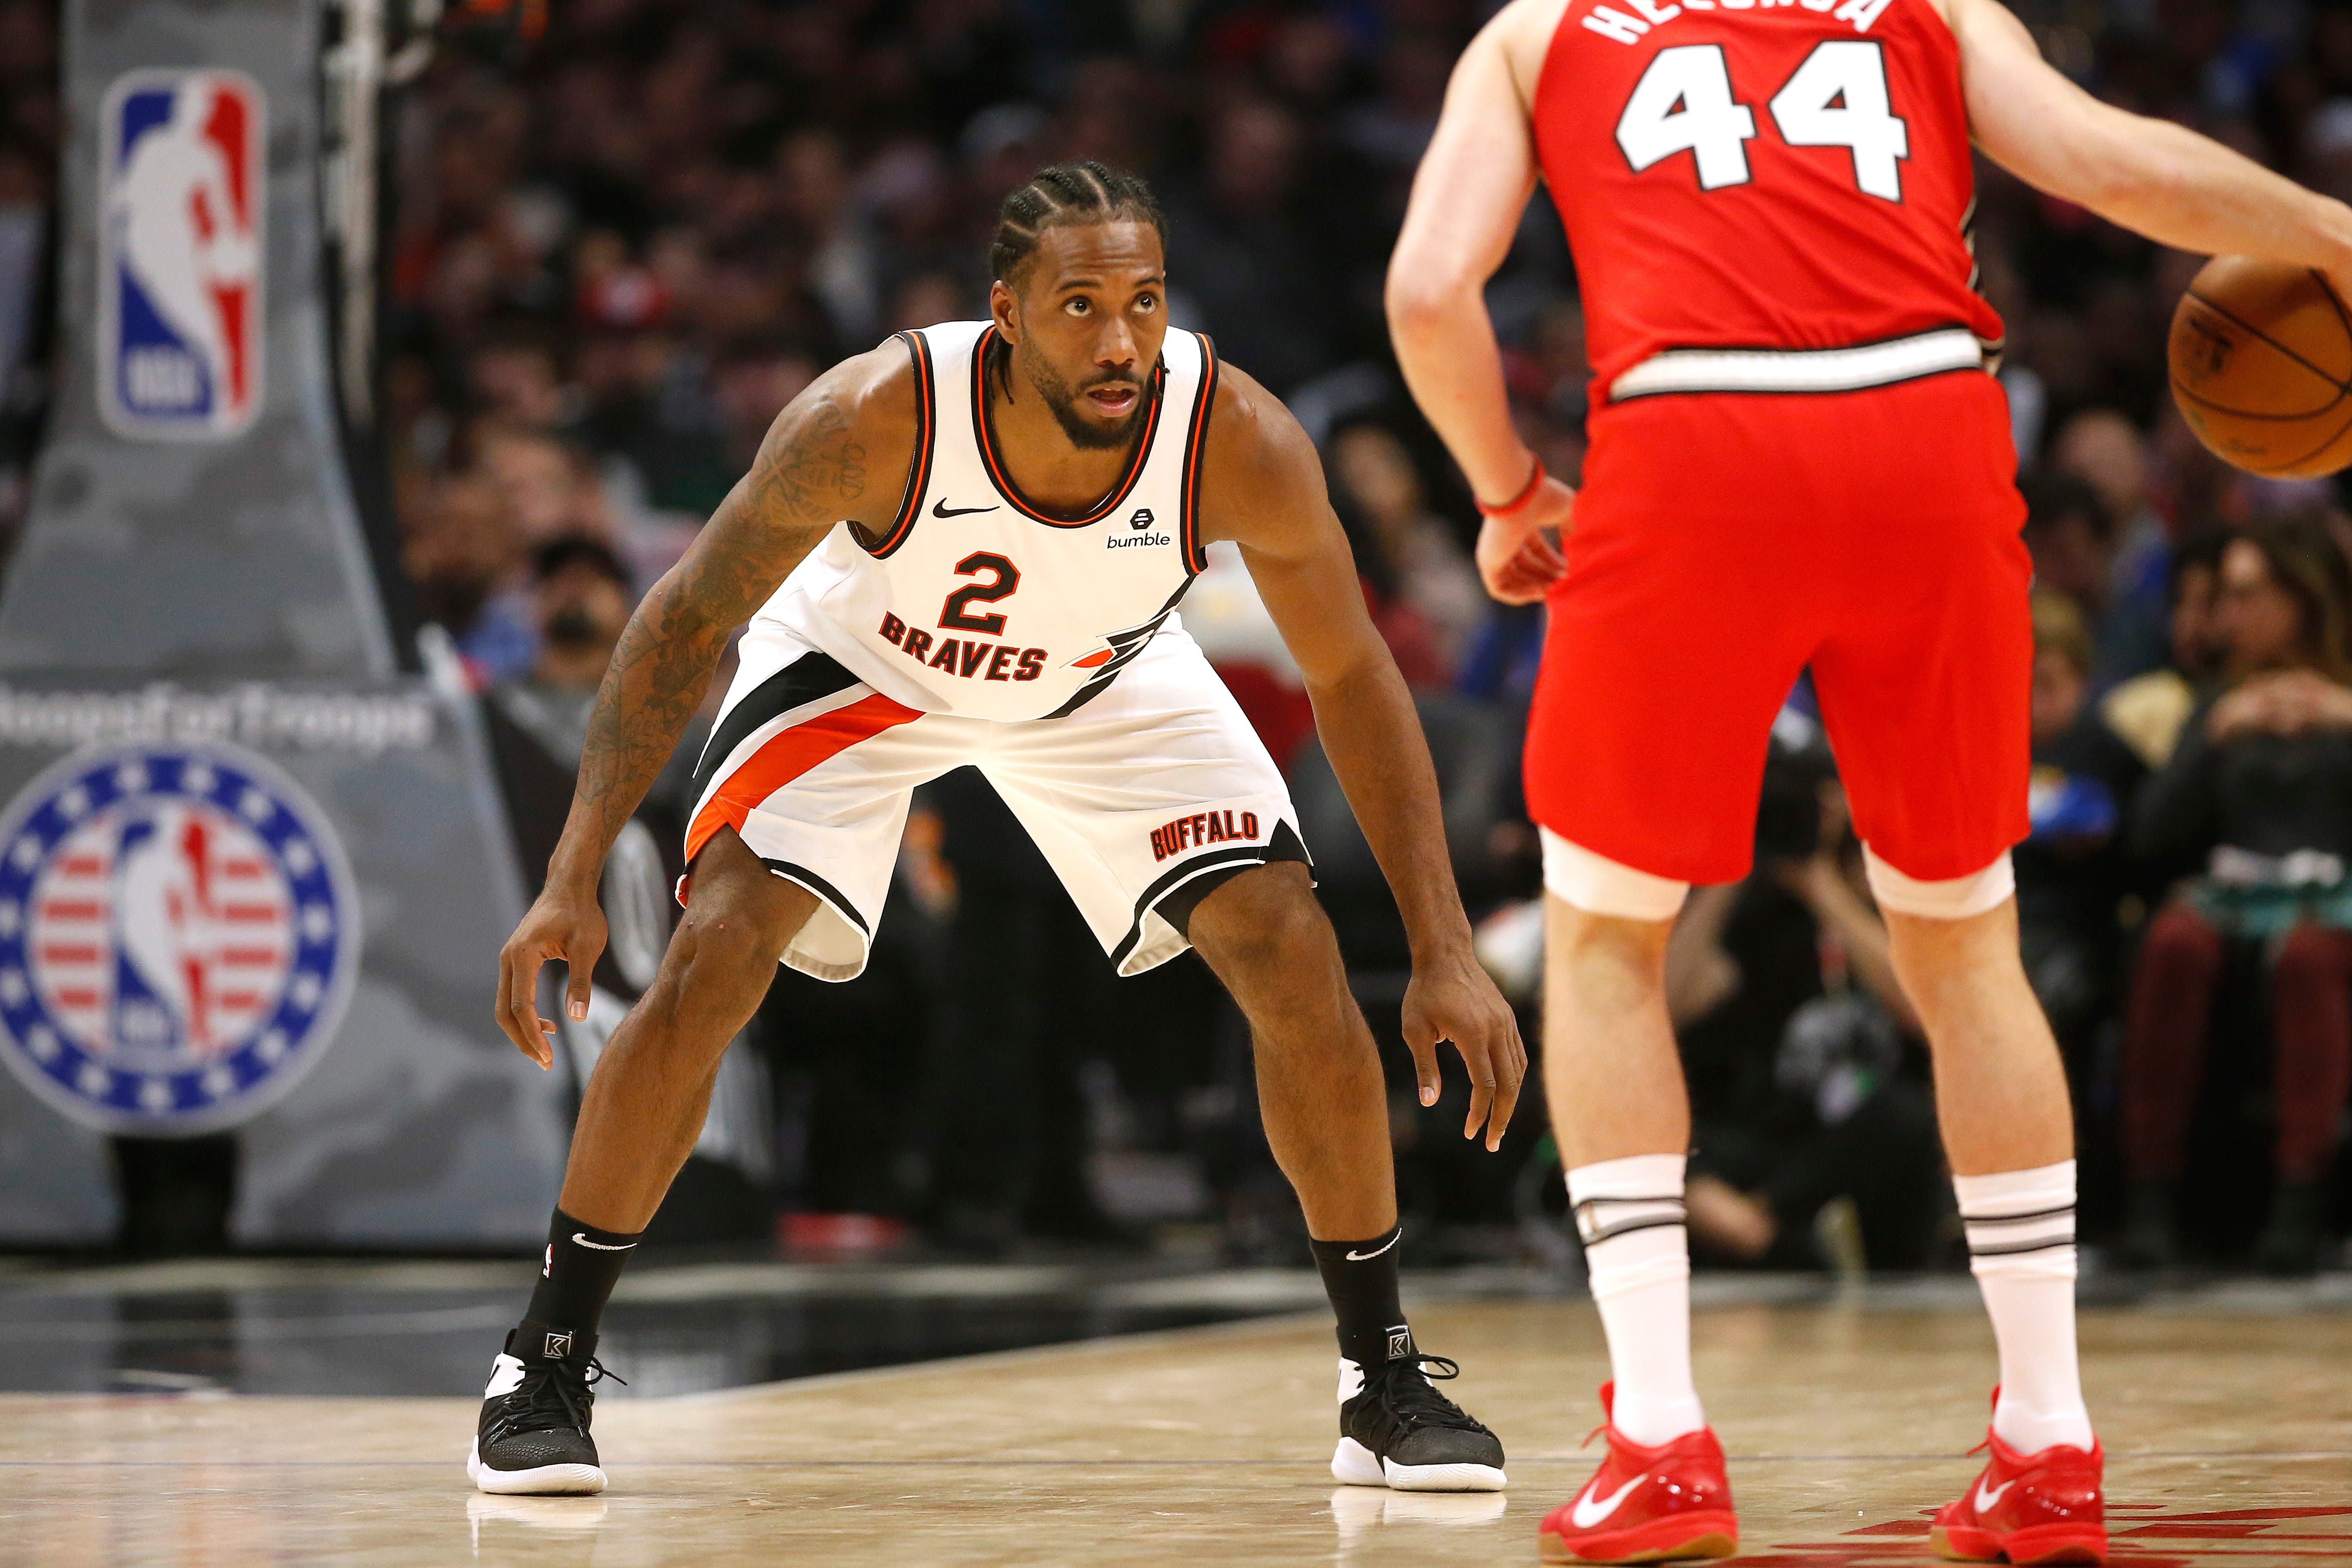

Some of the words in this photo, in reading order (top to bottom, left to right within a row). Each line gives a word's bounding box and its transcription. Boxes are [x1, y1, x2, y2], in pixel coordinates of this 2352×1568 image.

[1614, 39, 1910, 204] 44
[1107, 532, 1170, 549] bumble
[937, 551, 1021, 636] 2
[878, 611, 1048, 682] BRAVES
[1150, 810, 1259, 863] BUFFALO
